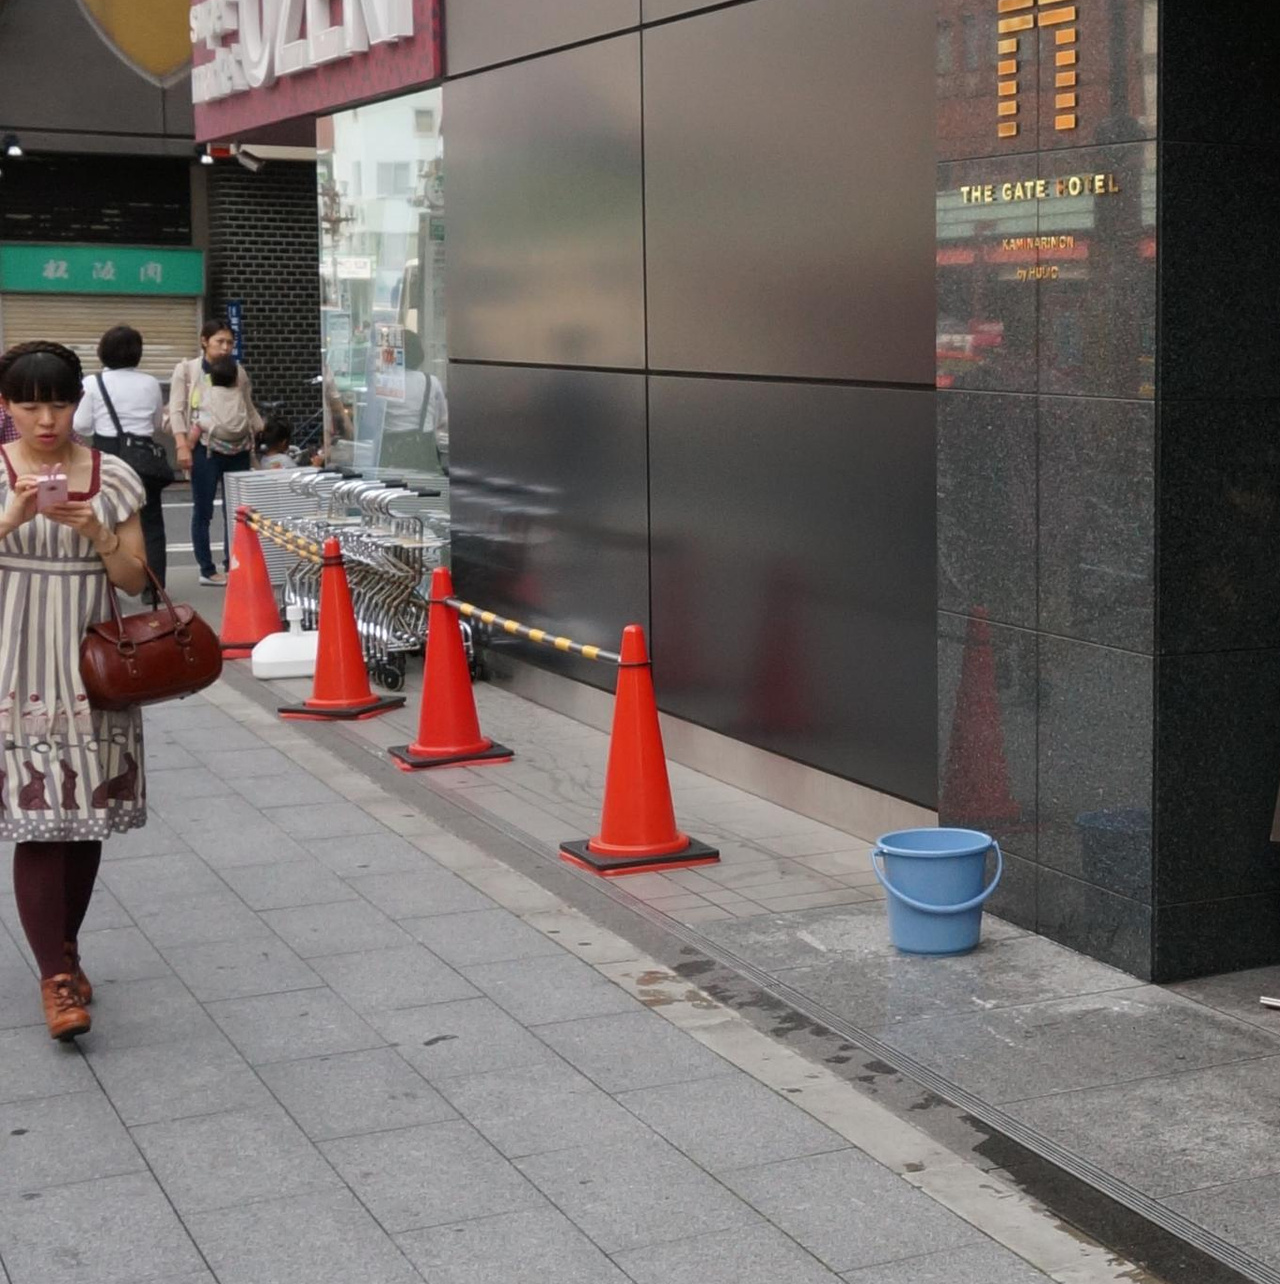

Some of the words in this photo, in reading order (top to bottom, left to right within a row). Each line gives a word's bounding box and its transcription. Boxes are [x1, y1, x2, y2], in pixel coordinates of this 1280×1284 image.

[960, 184, 994, 204] THE
[1002, 179, 1046, 201] GATE
[1055, 174, 1119, 198] HOTEL
[1002, 235, 1075, 251] KAMINARIMON
